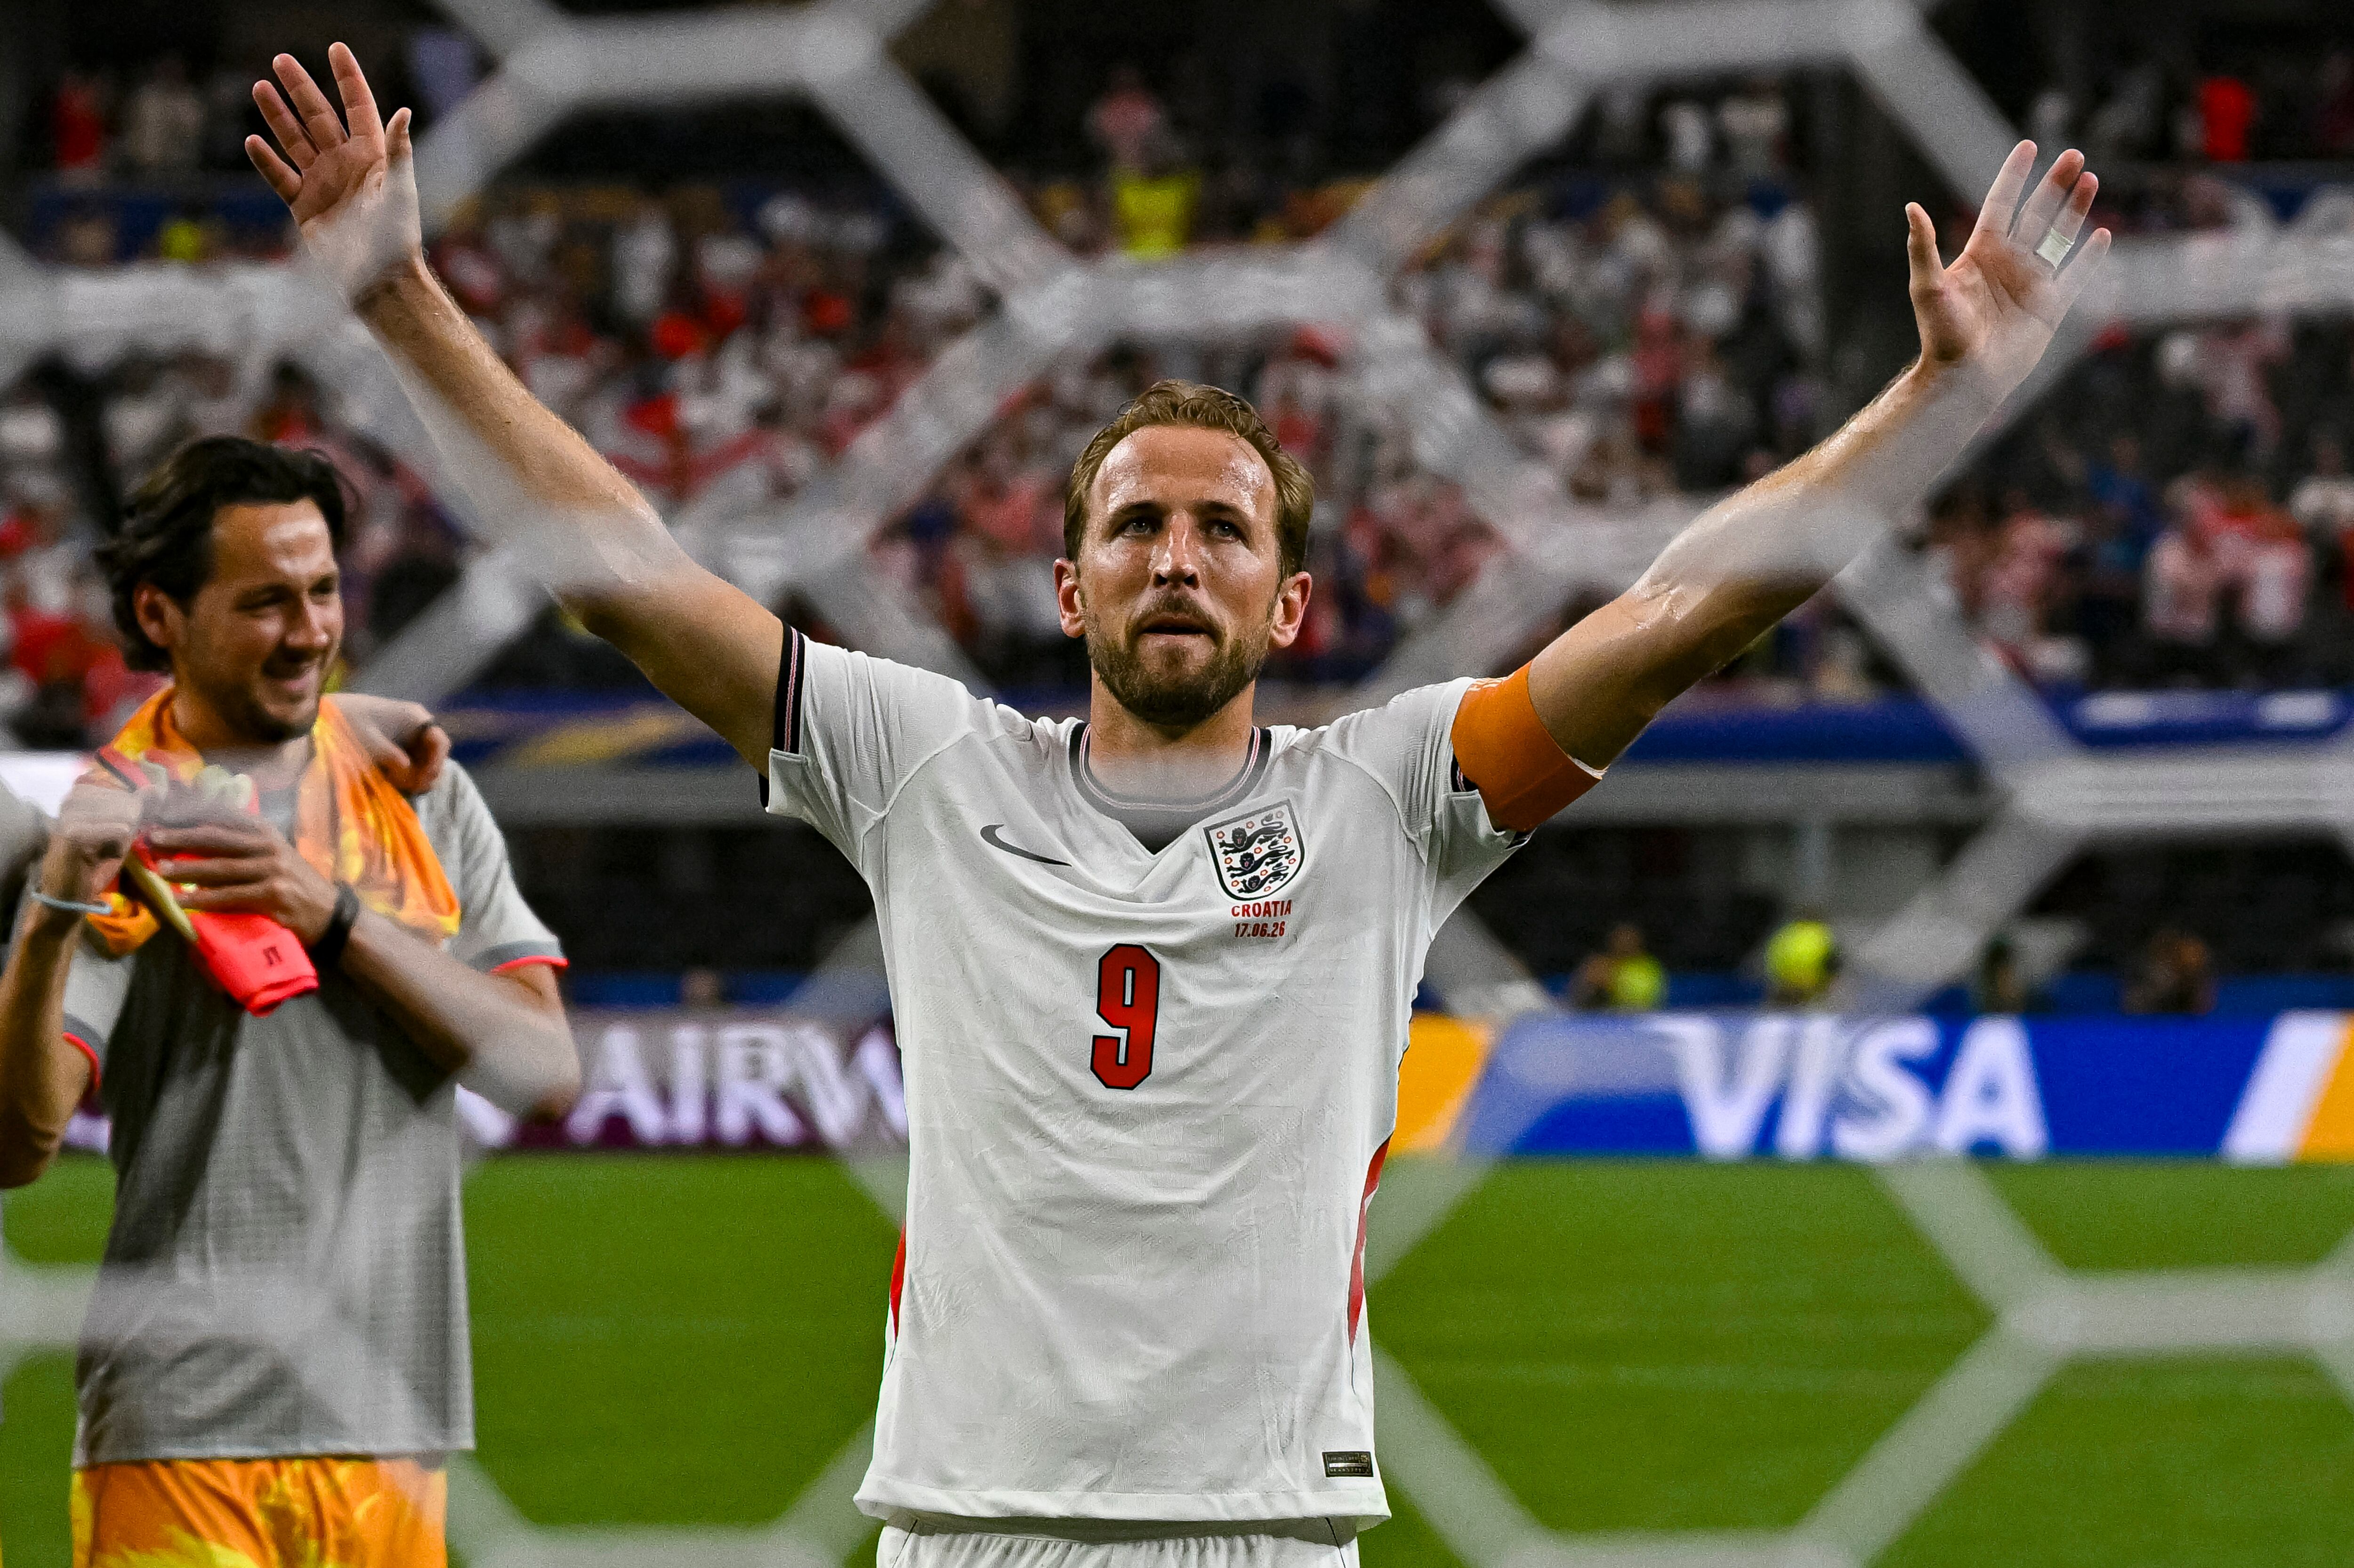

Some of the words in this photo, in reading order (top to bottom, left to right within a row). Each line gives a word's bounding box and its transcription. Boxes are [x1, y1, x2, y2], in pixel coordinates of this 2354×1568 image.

[1231, 899, 1292, 917] CROATIA
[1235, 920, 1286, 938] 17.06.26
[1090, 943, 1161, 1091] 9
[1650, 1014, 2052, 1159] VISA
